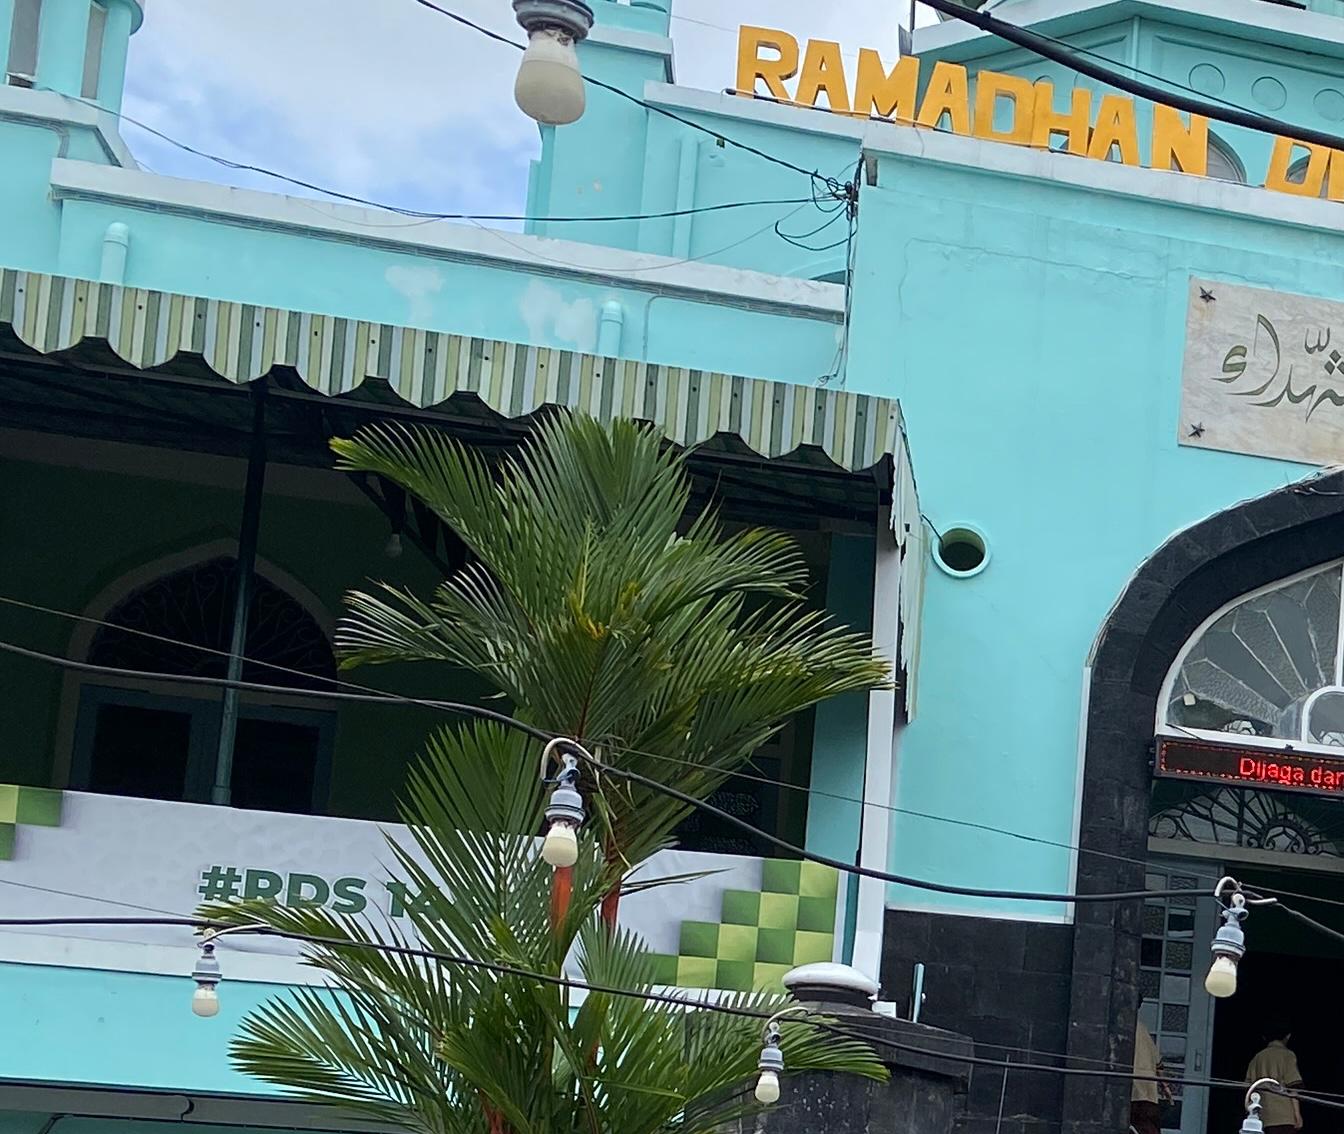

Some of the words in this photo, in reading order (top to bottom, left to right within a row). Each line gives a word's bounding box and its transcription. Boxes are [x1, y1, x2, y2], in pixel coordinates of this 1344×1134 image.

[736, 25, 1207, 177] RAMADHAN
[1239, 757, 1304, 784] Dijaga
[198, 865, 368, 914] #RDS
